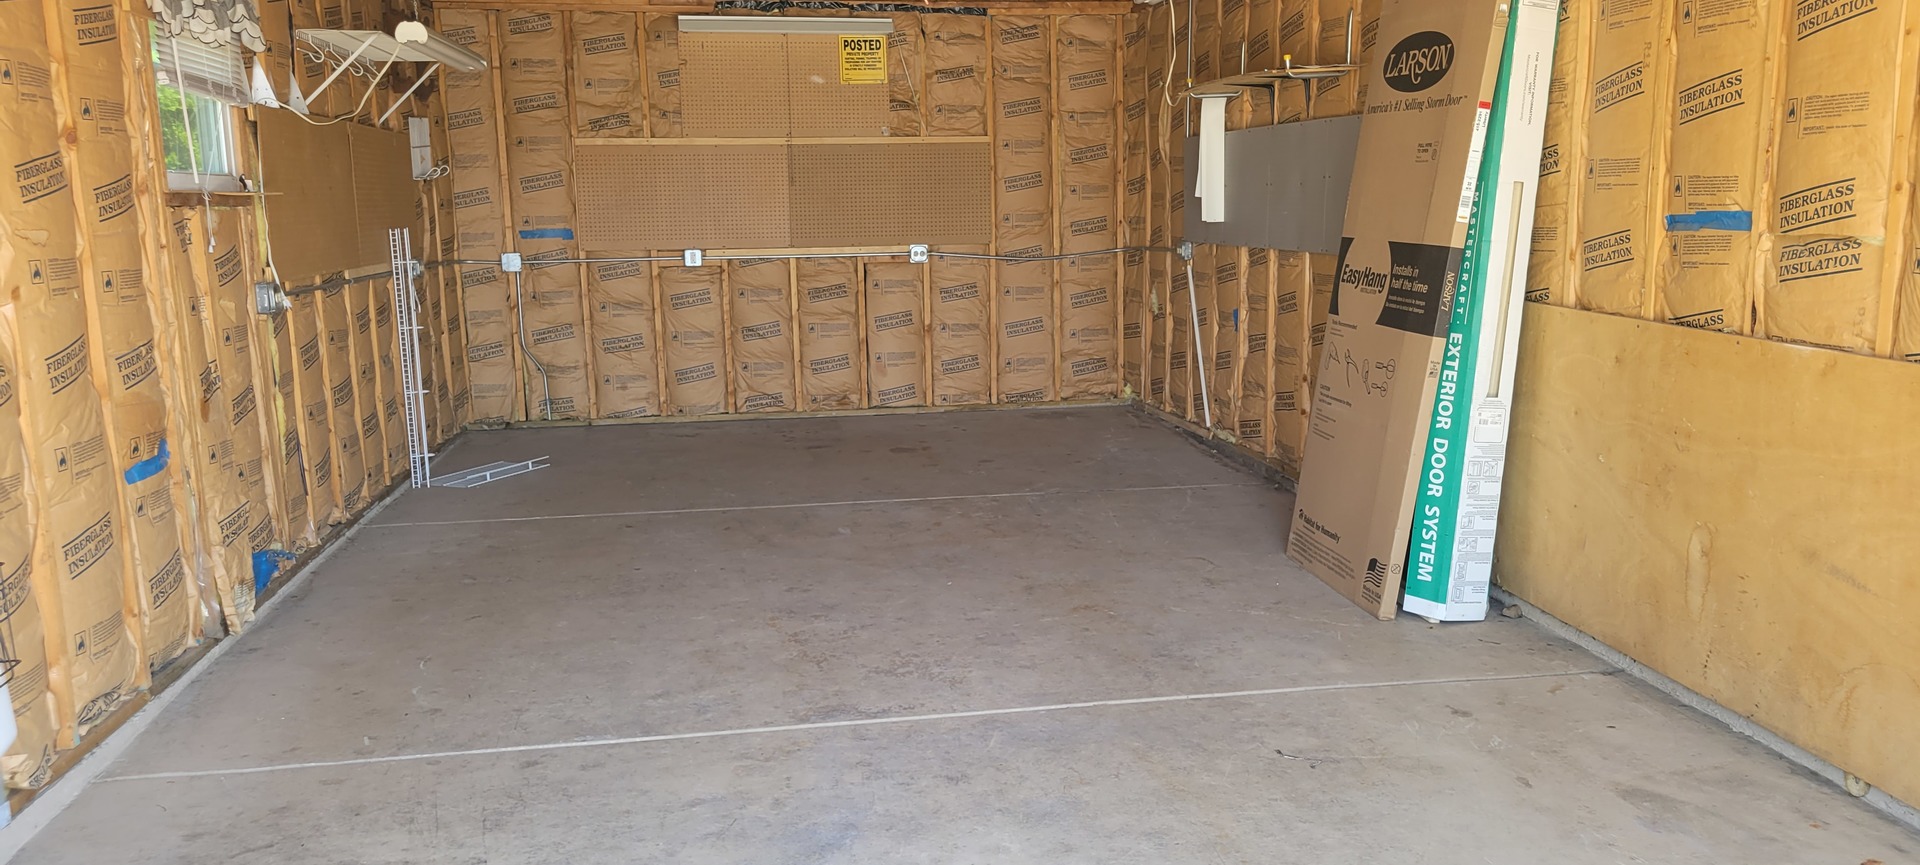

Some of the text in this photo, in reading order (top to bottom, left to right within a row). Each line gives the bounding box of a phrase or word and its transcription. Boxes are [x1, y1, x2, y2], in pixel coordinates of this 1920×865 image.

[508, 16, 551, 27] FIBERGLASS
[1797, 0, 1874, 35] INSULATION
[510, 22, 552, 33] INSULATION
[443, 29, 476, 39] ERGLASS
[583, 36, 625, 48] FIBERGLASS
[585, 42, 626, 53] INSULATION
[843, 40, 882, 51] POSTED
[1385, 44, 1452, 85] LARSON
[1069, 72, 1106, 83] FIBERGLASS
[1070, 78, 1107, 89] INSULATION
[1595, 66, 1643, 97] FIBERGLASS
[1595, 79, 1643, 109] INSULATION
[1679, 74, 1743, 107] FIBERGLASS
[514, 94, 557, 106] FIBERGLASS
[1003, 99, 1041, 111] FIBERGLASS
[1366, 101, 1392, 114] America's
[1394, 100, 1402, 112] #1
[1403, 98, 1425, 113] Selling
[1426, 97, 1444, 109] Storm
[1679, 89, 1743, 121] INSULATION
[516, 101, 558, 112] INSULATION
[1004, 105, 1042, 116] INSULATION
[448, 116, 483, 128] SULATION
[1070, 145, 1107, 157] FIBERGLASS
[1071, 151, 1108, 163] INSULATION
[16, 157, 62, 182] FIBERGLASS
[520, 173, 563, 186] FIBERGLASS
[1004, 173, 1042, 185] FIBERGLASS
[1006, 179, 1043, 191] INSULATION
[522, 179, 564, 192] INSULATION
[455, 195, 490, 207] NSULATION
[1779, 184, 1855, 214] FIBERGLASS
[1779, 199, 1855, 229] INSULATION
[1071, 217, 1108, 229] FIBERGLASS
[1071, 223, 1108, 235] INSULATION
[1584, 234, 1631, 255] FIBERGLASS
[1779, 238, 1863, 262] FIBERGLASS
[1457, 191, 1479, 315] MASTERCRAFT
[1584, 247, 1633, 267] INSULATION
[598, 262, 639, 273] FIBERGLASS
[1392, 264, 1419, 278] Installs in
[1779, 253, 1862, 277] INSULATION
[463, 269, 496, 279] ERGLASS
[464, 274, 497, 286] SULATION
[600, 268, 641, 280] INSULATION
[1341, 264, 1388, 294] EasyHang
[808, 285, 847, 296] FIBERGLASS
[940, 284, 978, 296] FIBERGLASS
[1391, 277, 1428, 293] half the time
[670, 290, 711, 302] FIBERGLASS
[810, 290, 848, 301] INSULATION
[1070, 290, 1107, 301] FIBERGLASS
[1441, 271, 1455, 312] LARSON
[672, 296, 712, 308] INSULATION
[1071, 296, 1108, 307] INSULATION
[875, 312, 913, 324] FIBERGLASS
[876, 318, 914, 330] INSULATION
[742, 322, 780, 334] FIBERGLASS
[1005, 319, 1043, 331] FIBERGLASS
[1006, 324, 1044, 336] INSULATION
[532, 326, 573, 338] FIBERGLASS
[534, 331, 574, 343] INSULATION
[602, 335, 643, 346] FIBERGLASS
[604, 341, 644, 352] INSULATION
[470, 350, 504, 360] SULATION
[810, 356, 849, 367] FIBERGLASS
[812, 362, 850, 373] INSULATION
[942, 356, 979, 368] FIBERGLASS
[943, 362, 980, 373] INSULATION
[675, 364, 715, 377] FIBERGLASS
[1073, 363, 1108, 376] INSULATION
[677, 370, 716, 383] INSULATION
[878, 385, 916, 398] FIBERGLASS
[880, 391, 916, 404] INSULATION
[1416, 332, 1463, 582] EXTERIOR DOOR SYSTEM
[220, 507, 250, 534] FIBERGL
[64, 517, 112, 562] FIBERGLASS
[1321, 525, 1341, 544] Humanity
[68, 531, 113, 575] INSULATION
